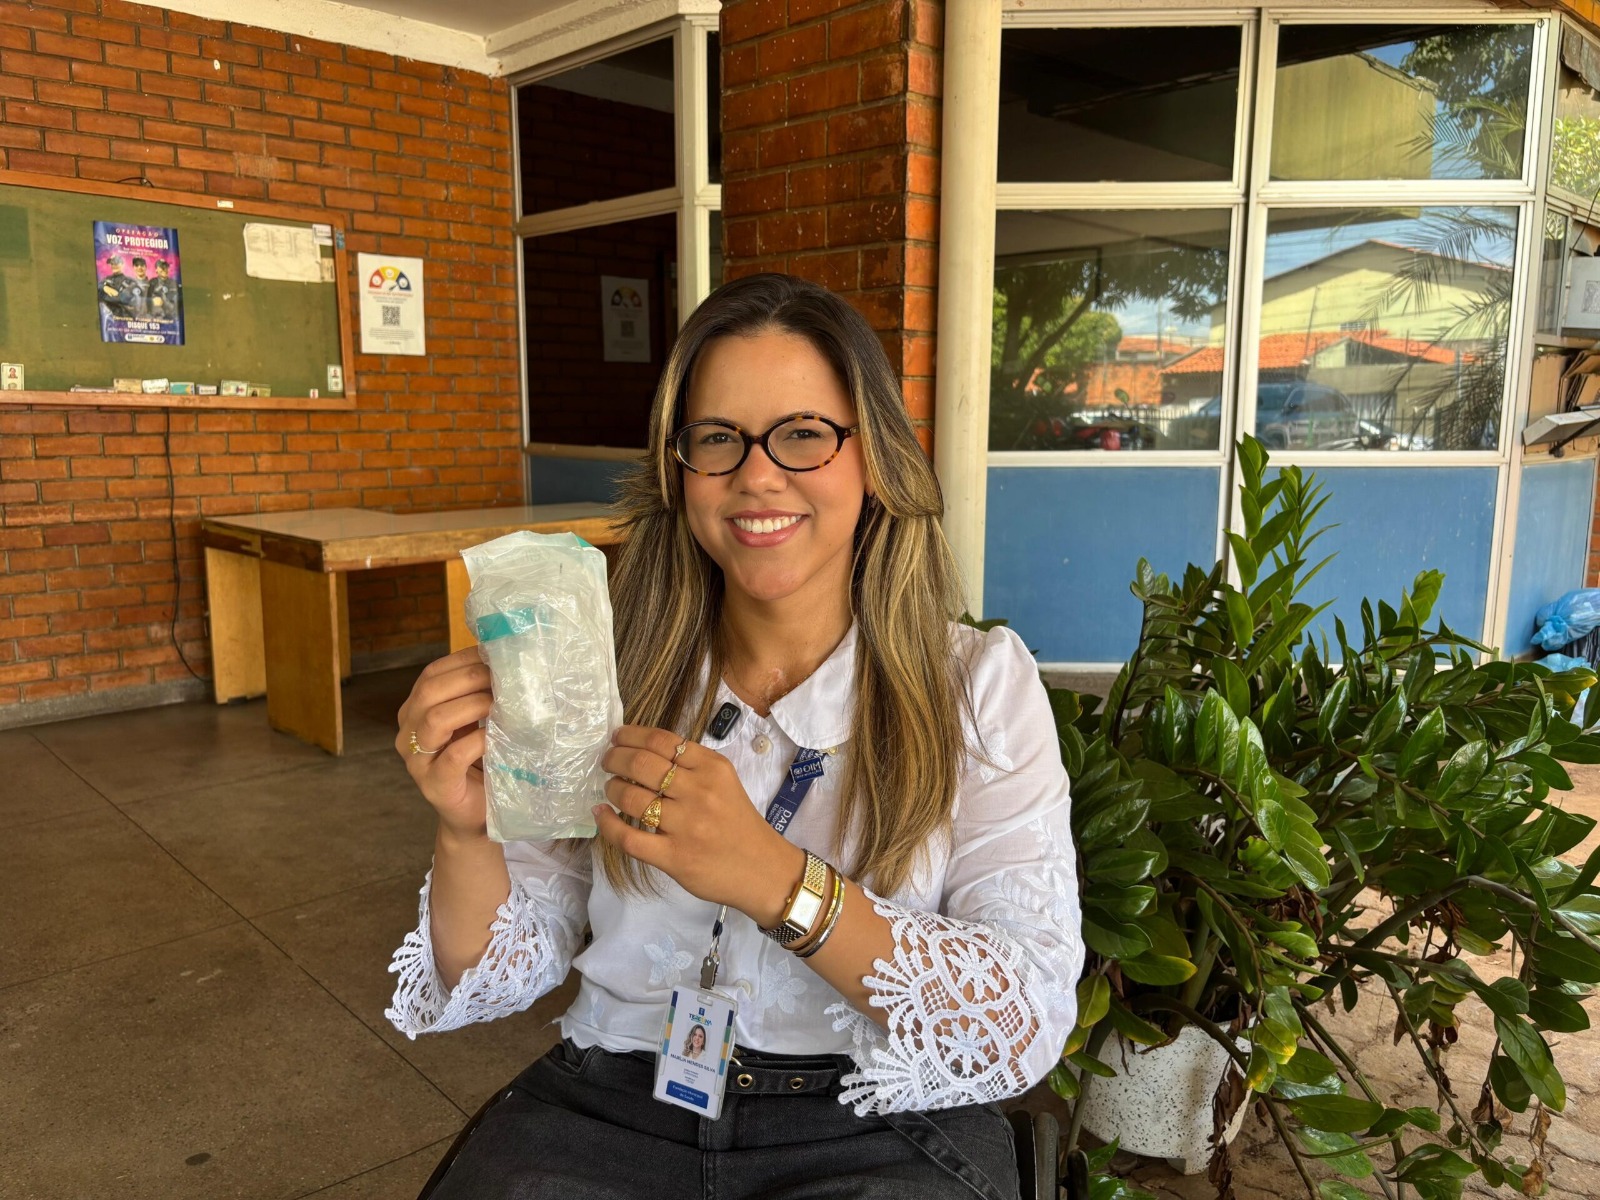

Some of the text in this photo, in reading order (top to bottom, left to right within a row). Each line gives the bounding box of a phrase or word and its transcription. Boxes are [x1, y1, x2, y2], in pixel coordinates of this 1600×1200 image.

[106, 234, 169, 249] VOZ PROTEGIDA
[775, 809, 792, 832] DAB
